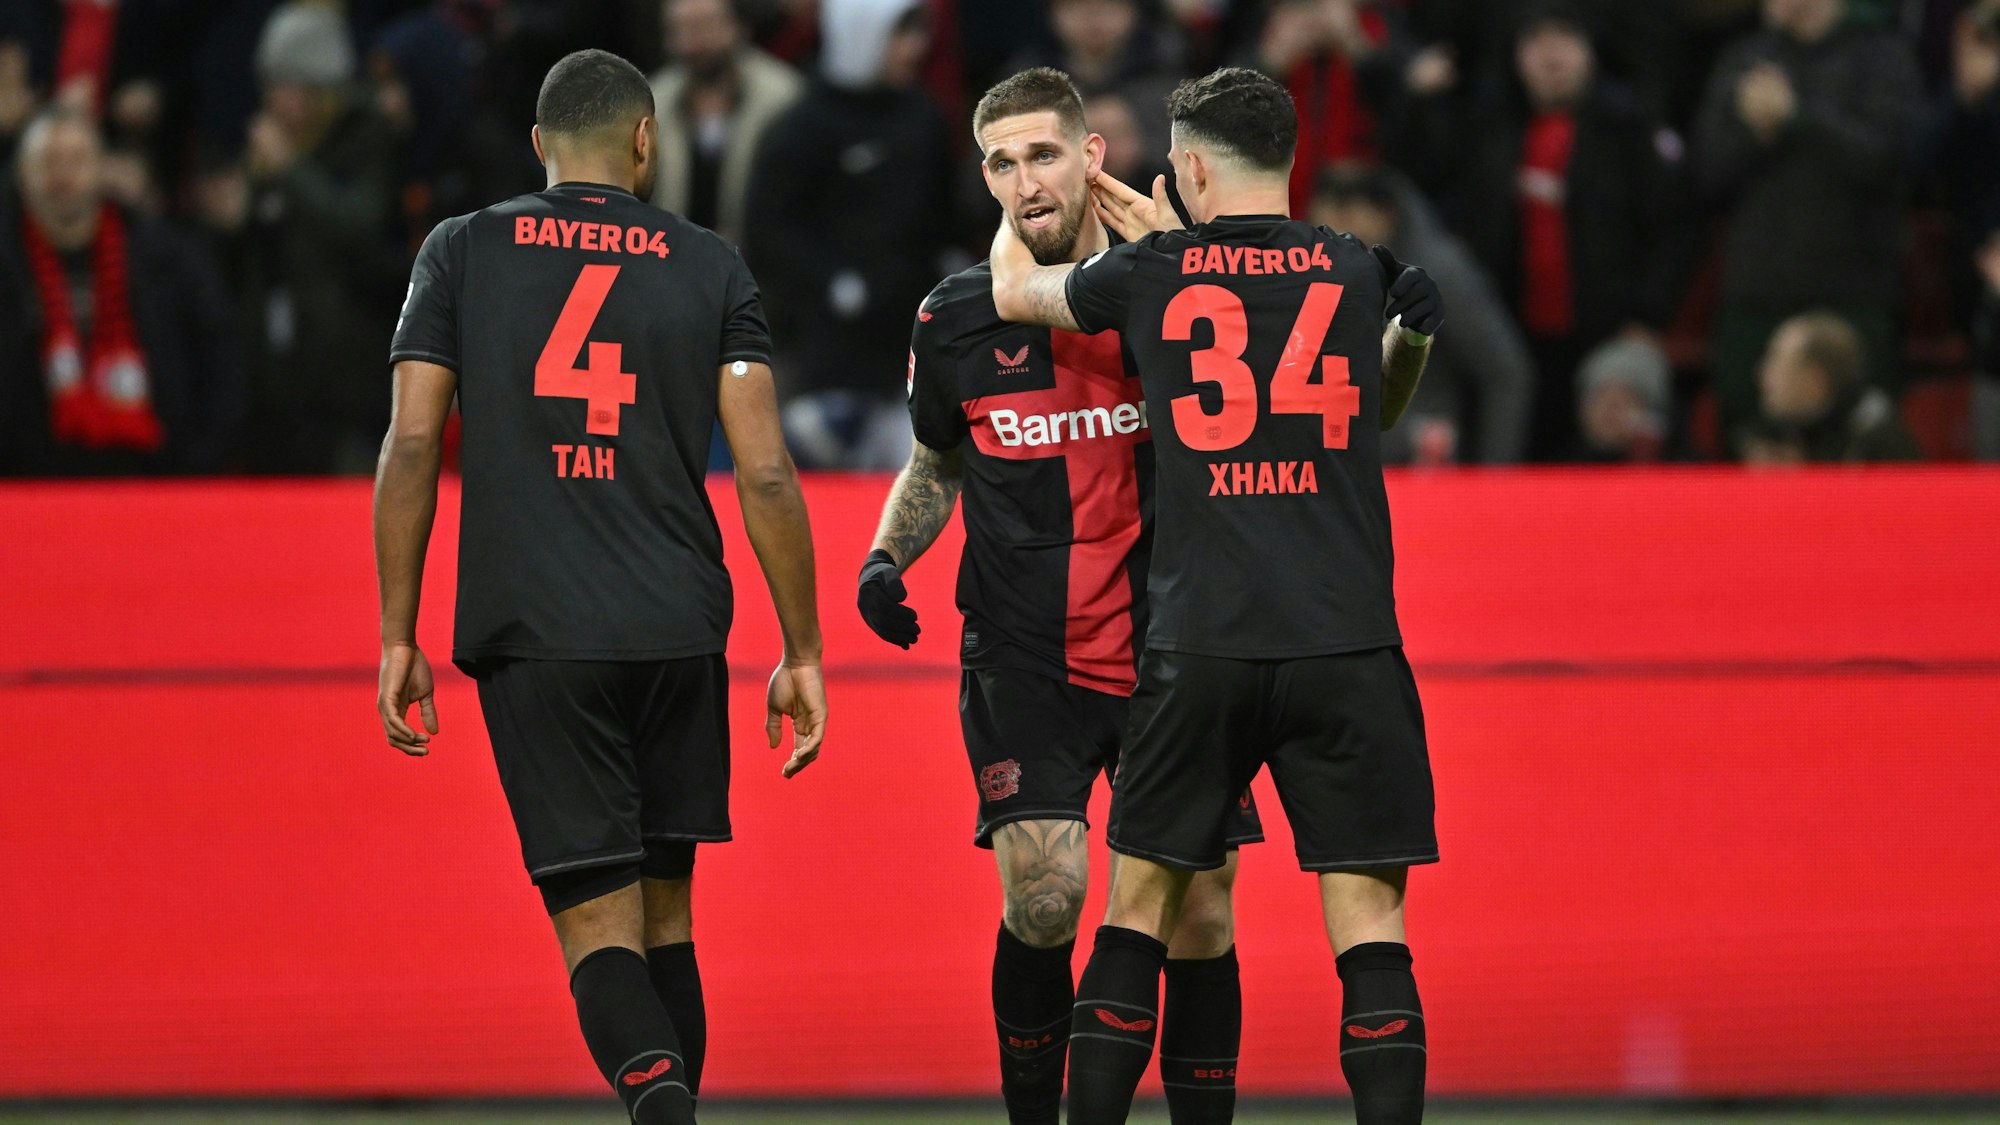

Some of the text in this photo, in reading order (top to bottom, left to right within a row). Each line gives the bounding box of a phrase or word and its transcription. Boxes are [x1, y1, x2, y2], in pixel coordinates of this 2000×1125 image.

[533, 263, 637, 436] 4
[1161, 282, 1360, 451] 34
[551, 444, 615, 481] TAH
[1208, 461, 1318, 497] XHAKA
